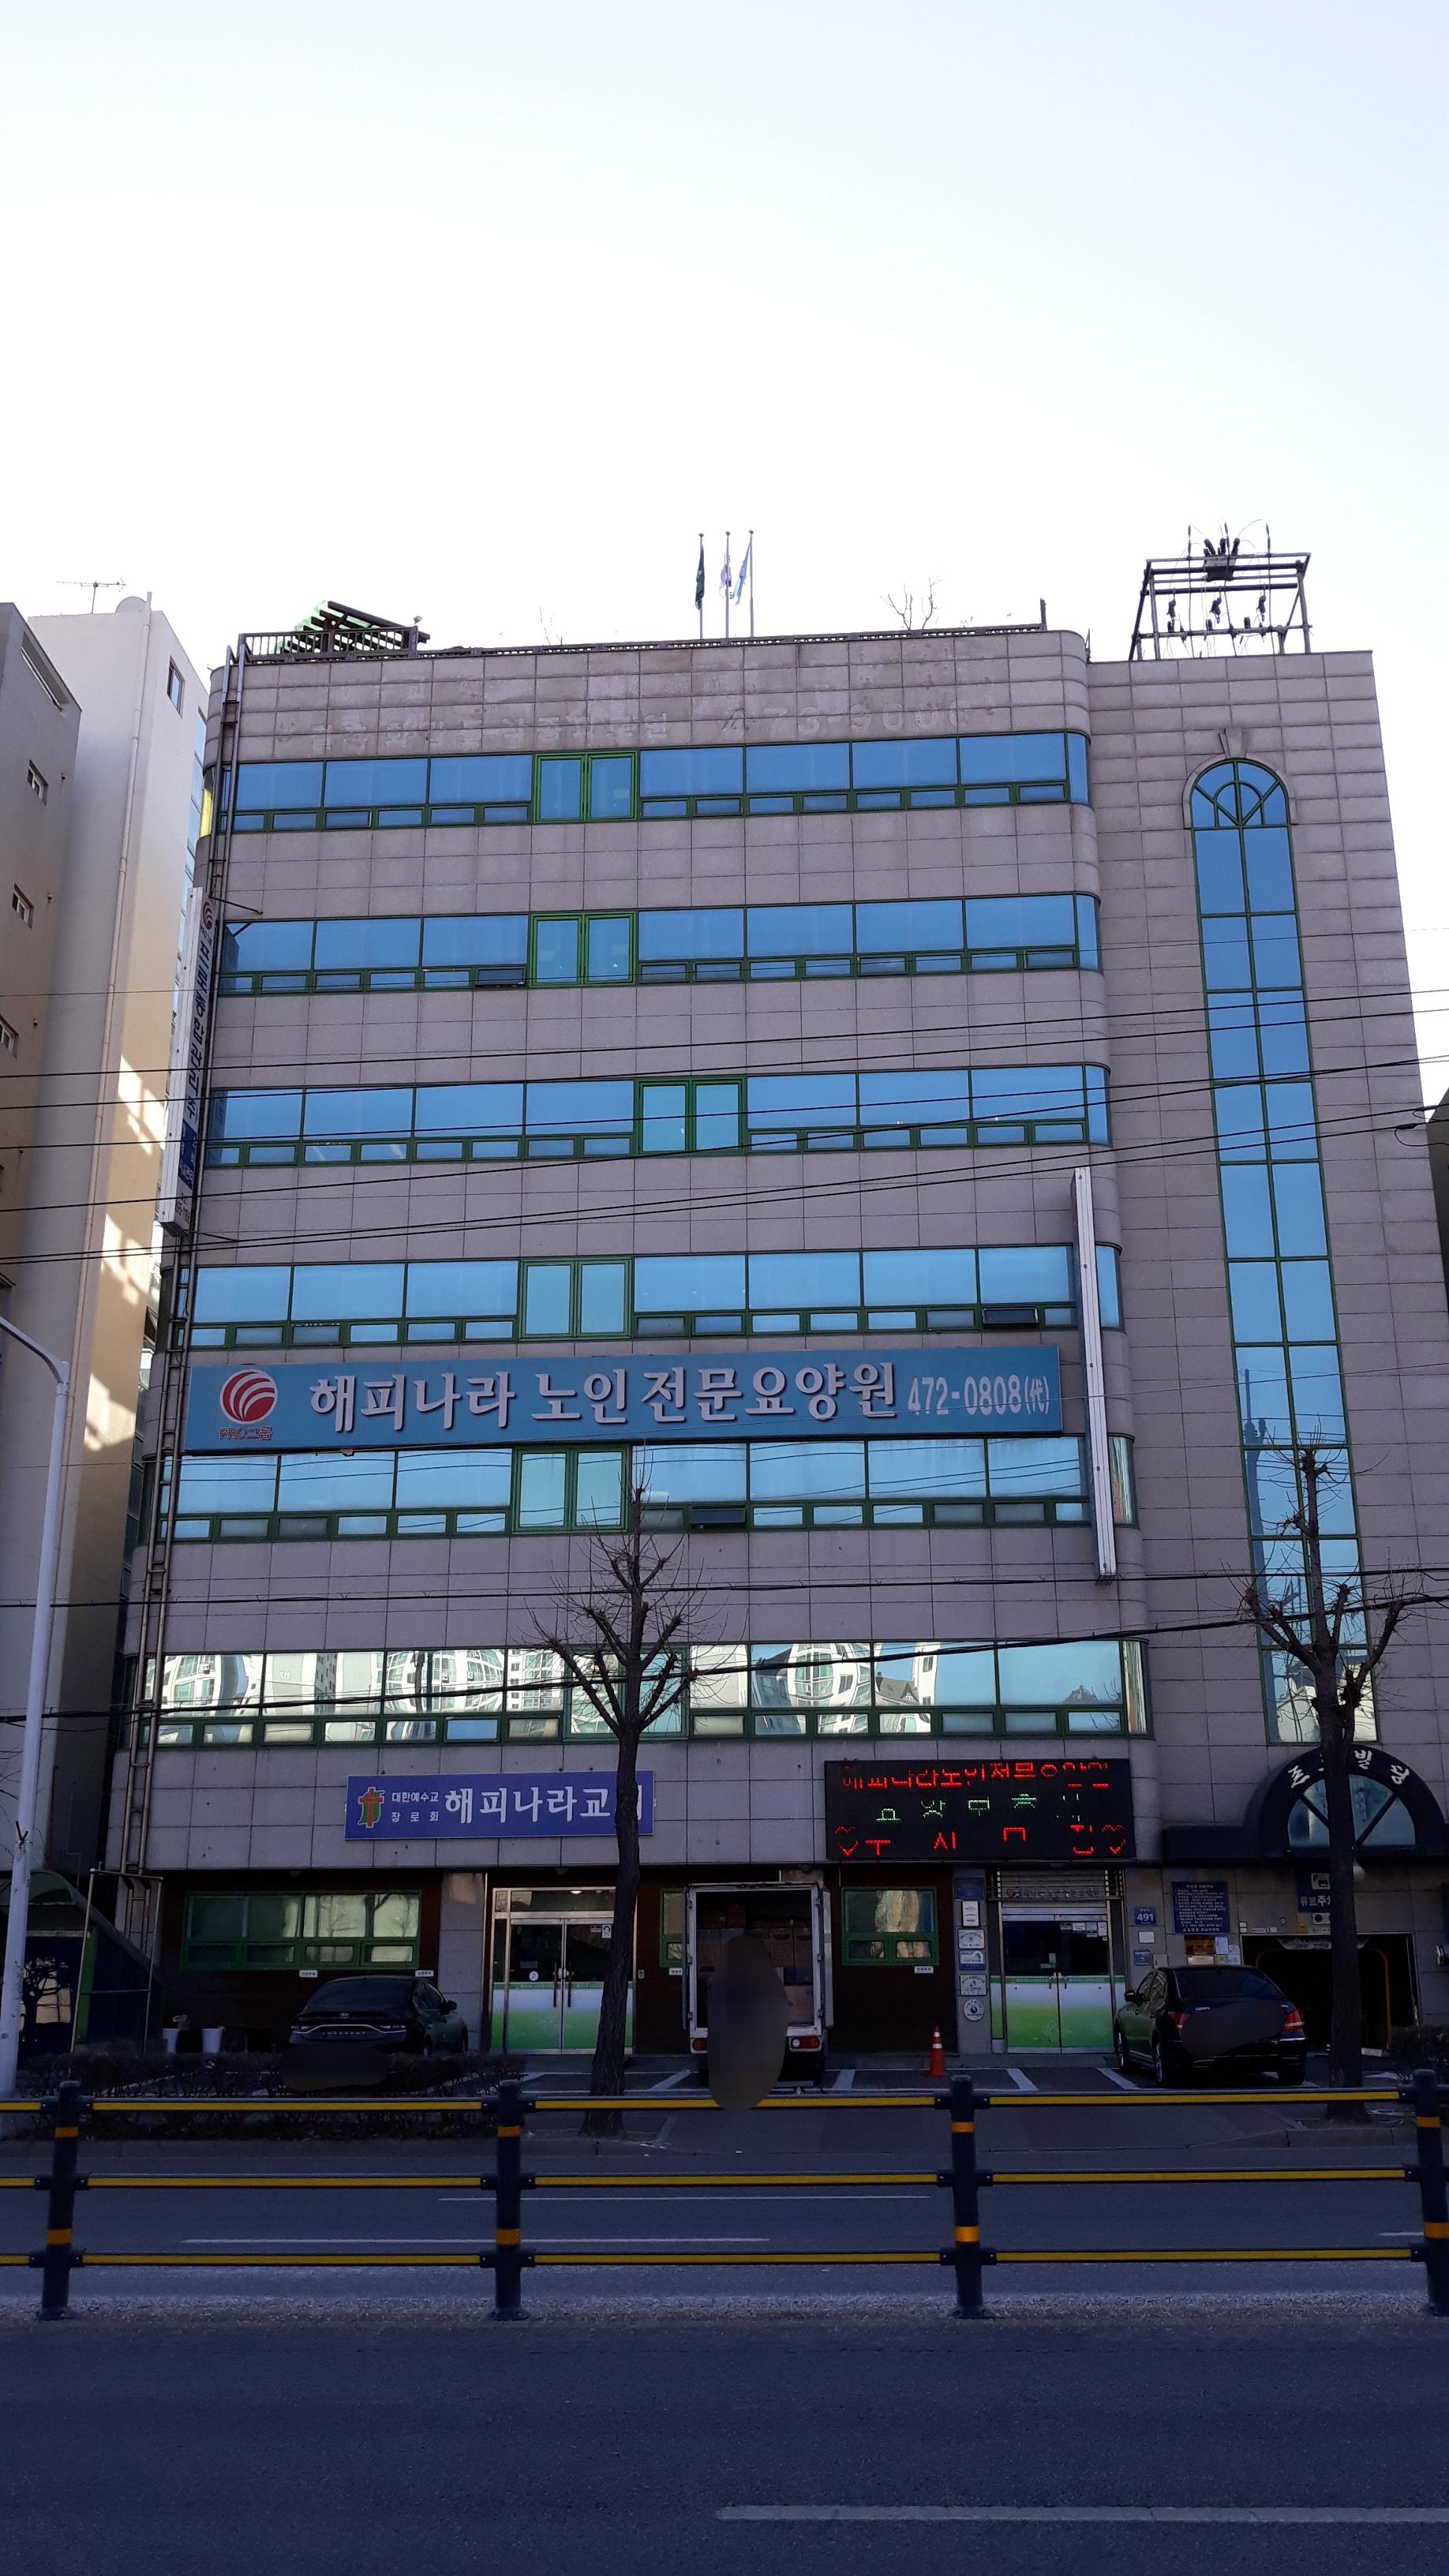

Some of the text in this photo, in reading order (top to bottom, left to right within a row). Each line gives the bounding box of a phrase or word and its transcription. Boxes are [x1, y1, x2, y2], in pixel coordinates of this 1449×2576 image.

[310, 1370, 516, 1432] 해피나라
[531, 1368, 627, 1424] 노인
[641, 1362, 897, 1423] 전문요양원
[219, 1426, 272, 1441] PRO그룹
[391, 1792, 440, 1803] 대한예수교
[445, 1785, 643, 1824] 해피나라교
